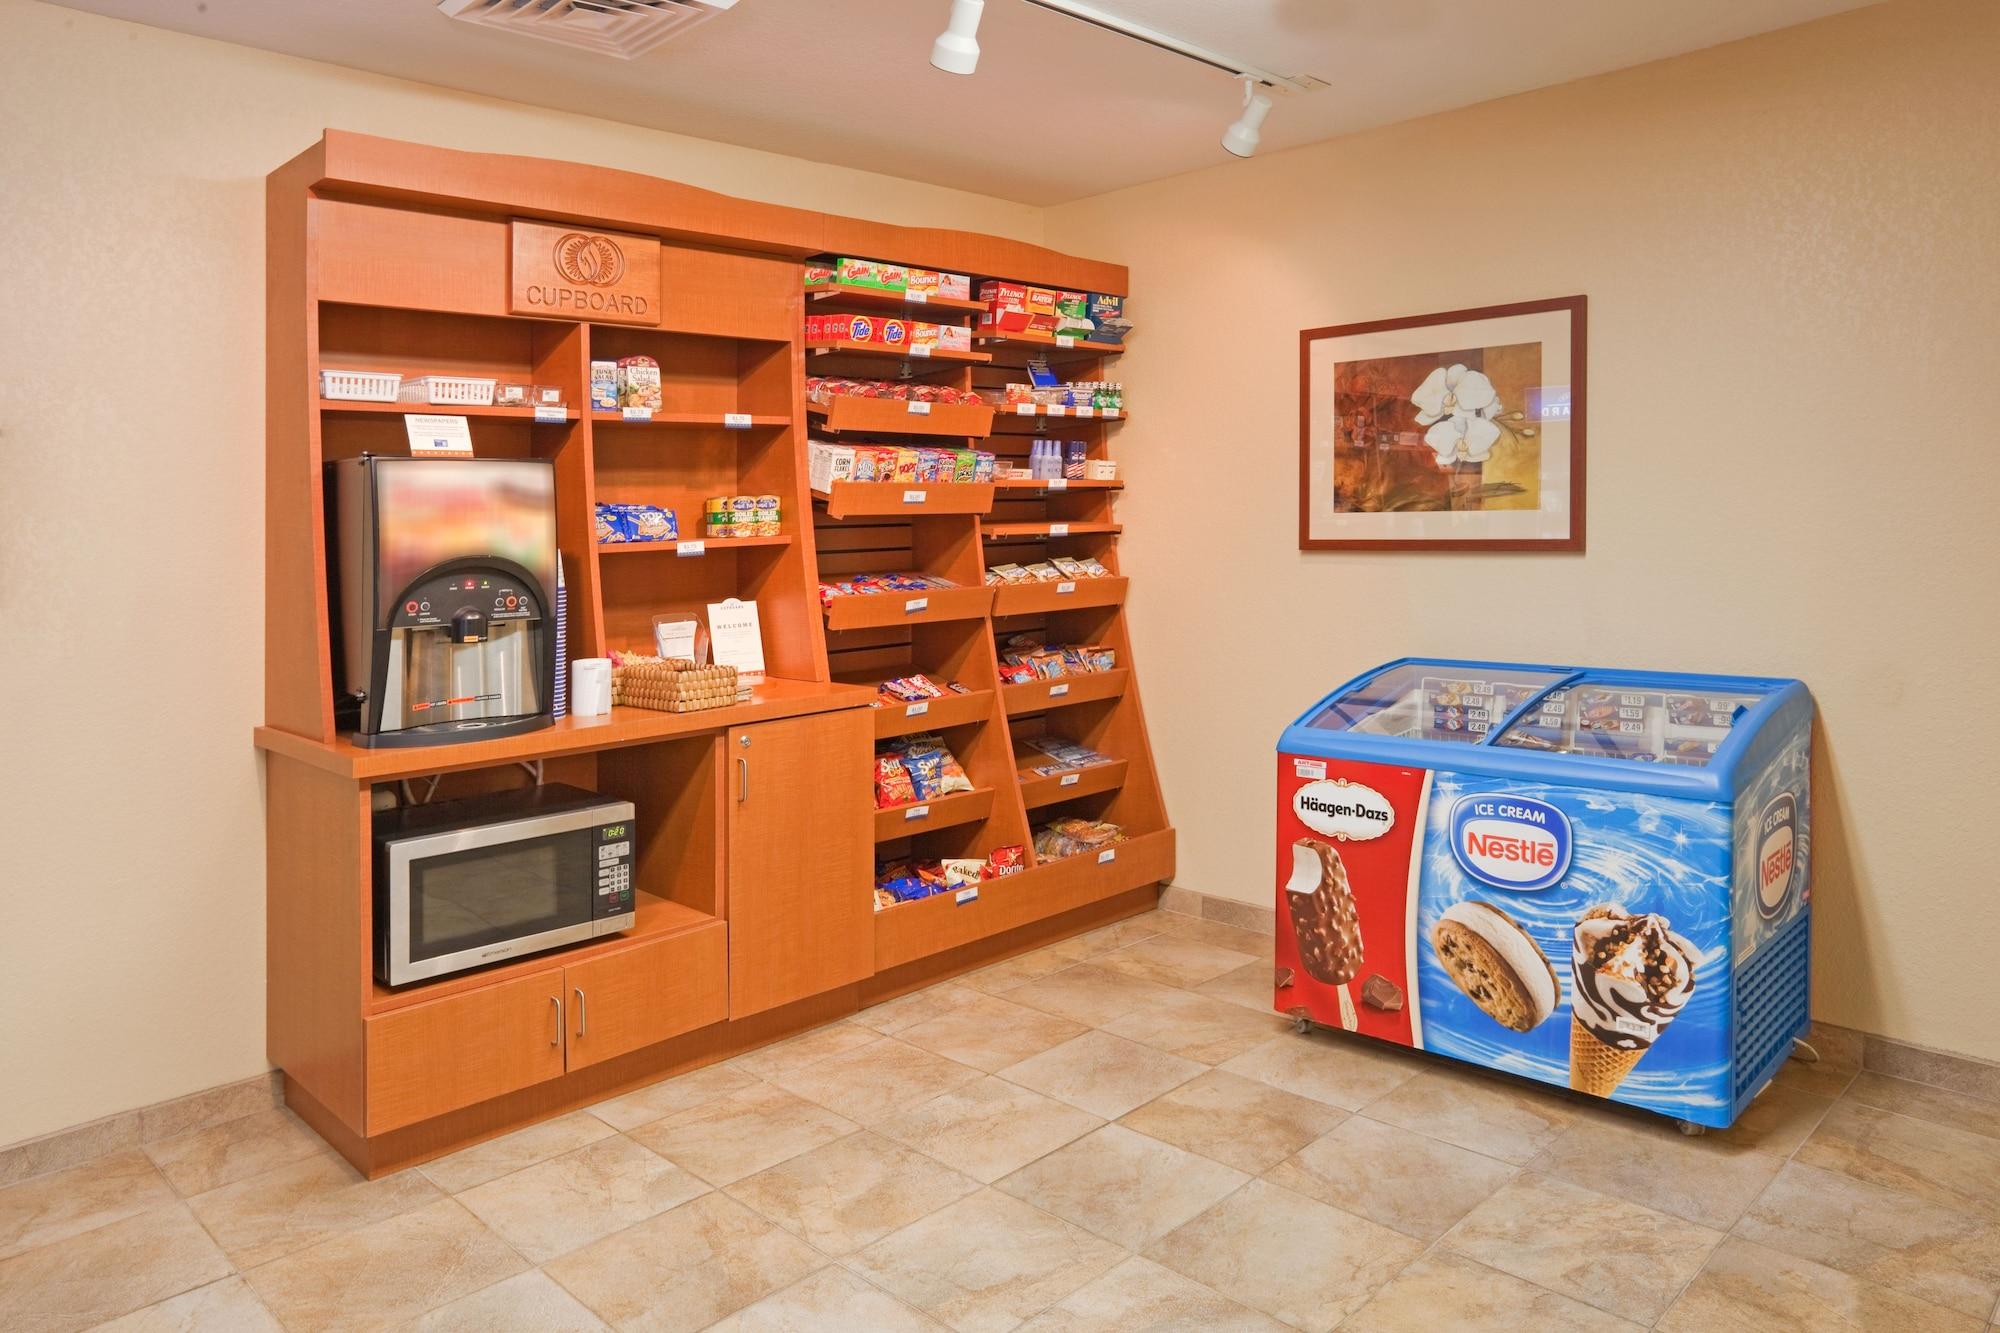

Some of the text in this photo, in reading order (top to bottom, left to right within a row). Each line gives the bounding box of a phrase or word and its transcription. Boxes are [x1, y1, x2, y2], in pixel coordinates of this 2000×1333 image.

[847, 264, 871, 280] GAIN
[880, 269, 903, 285] GAIN
[910, 274, 937, 285] Bounce
[526, 284, 648, 316] CUPBOARD
[999, 286, 1025, 299] TYLENOL
[1031, 293, 1054, 304] BAYER
[1097, 295, 1119, 306] Advil
[852, 321, 871, 339] Tide
[885, 325, 903, 342] Tide
[915, 326, 937, 338] Bounce
[630, 367, 658, 376] Chicken
[835, 458, 851, 466] CORN
[899, 462, 917, 474] POPS
[717, 622, 753, 630] WELCOME
[880, 758, 900, 773] Sun
[917, 757, 941, 775] Sun
[1300, 795, 1389, 822] Häagen-Dazs
[1474, 803, 1546, 824] ICE CREAM
[1763, 806, 1790, 835] ICE CREAM
